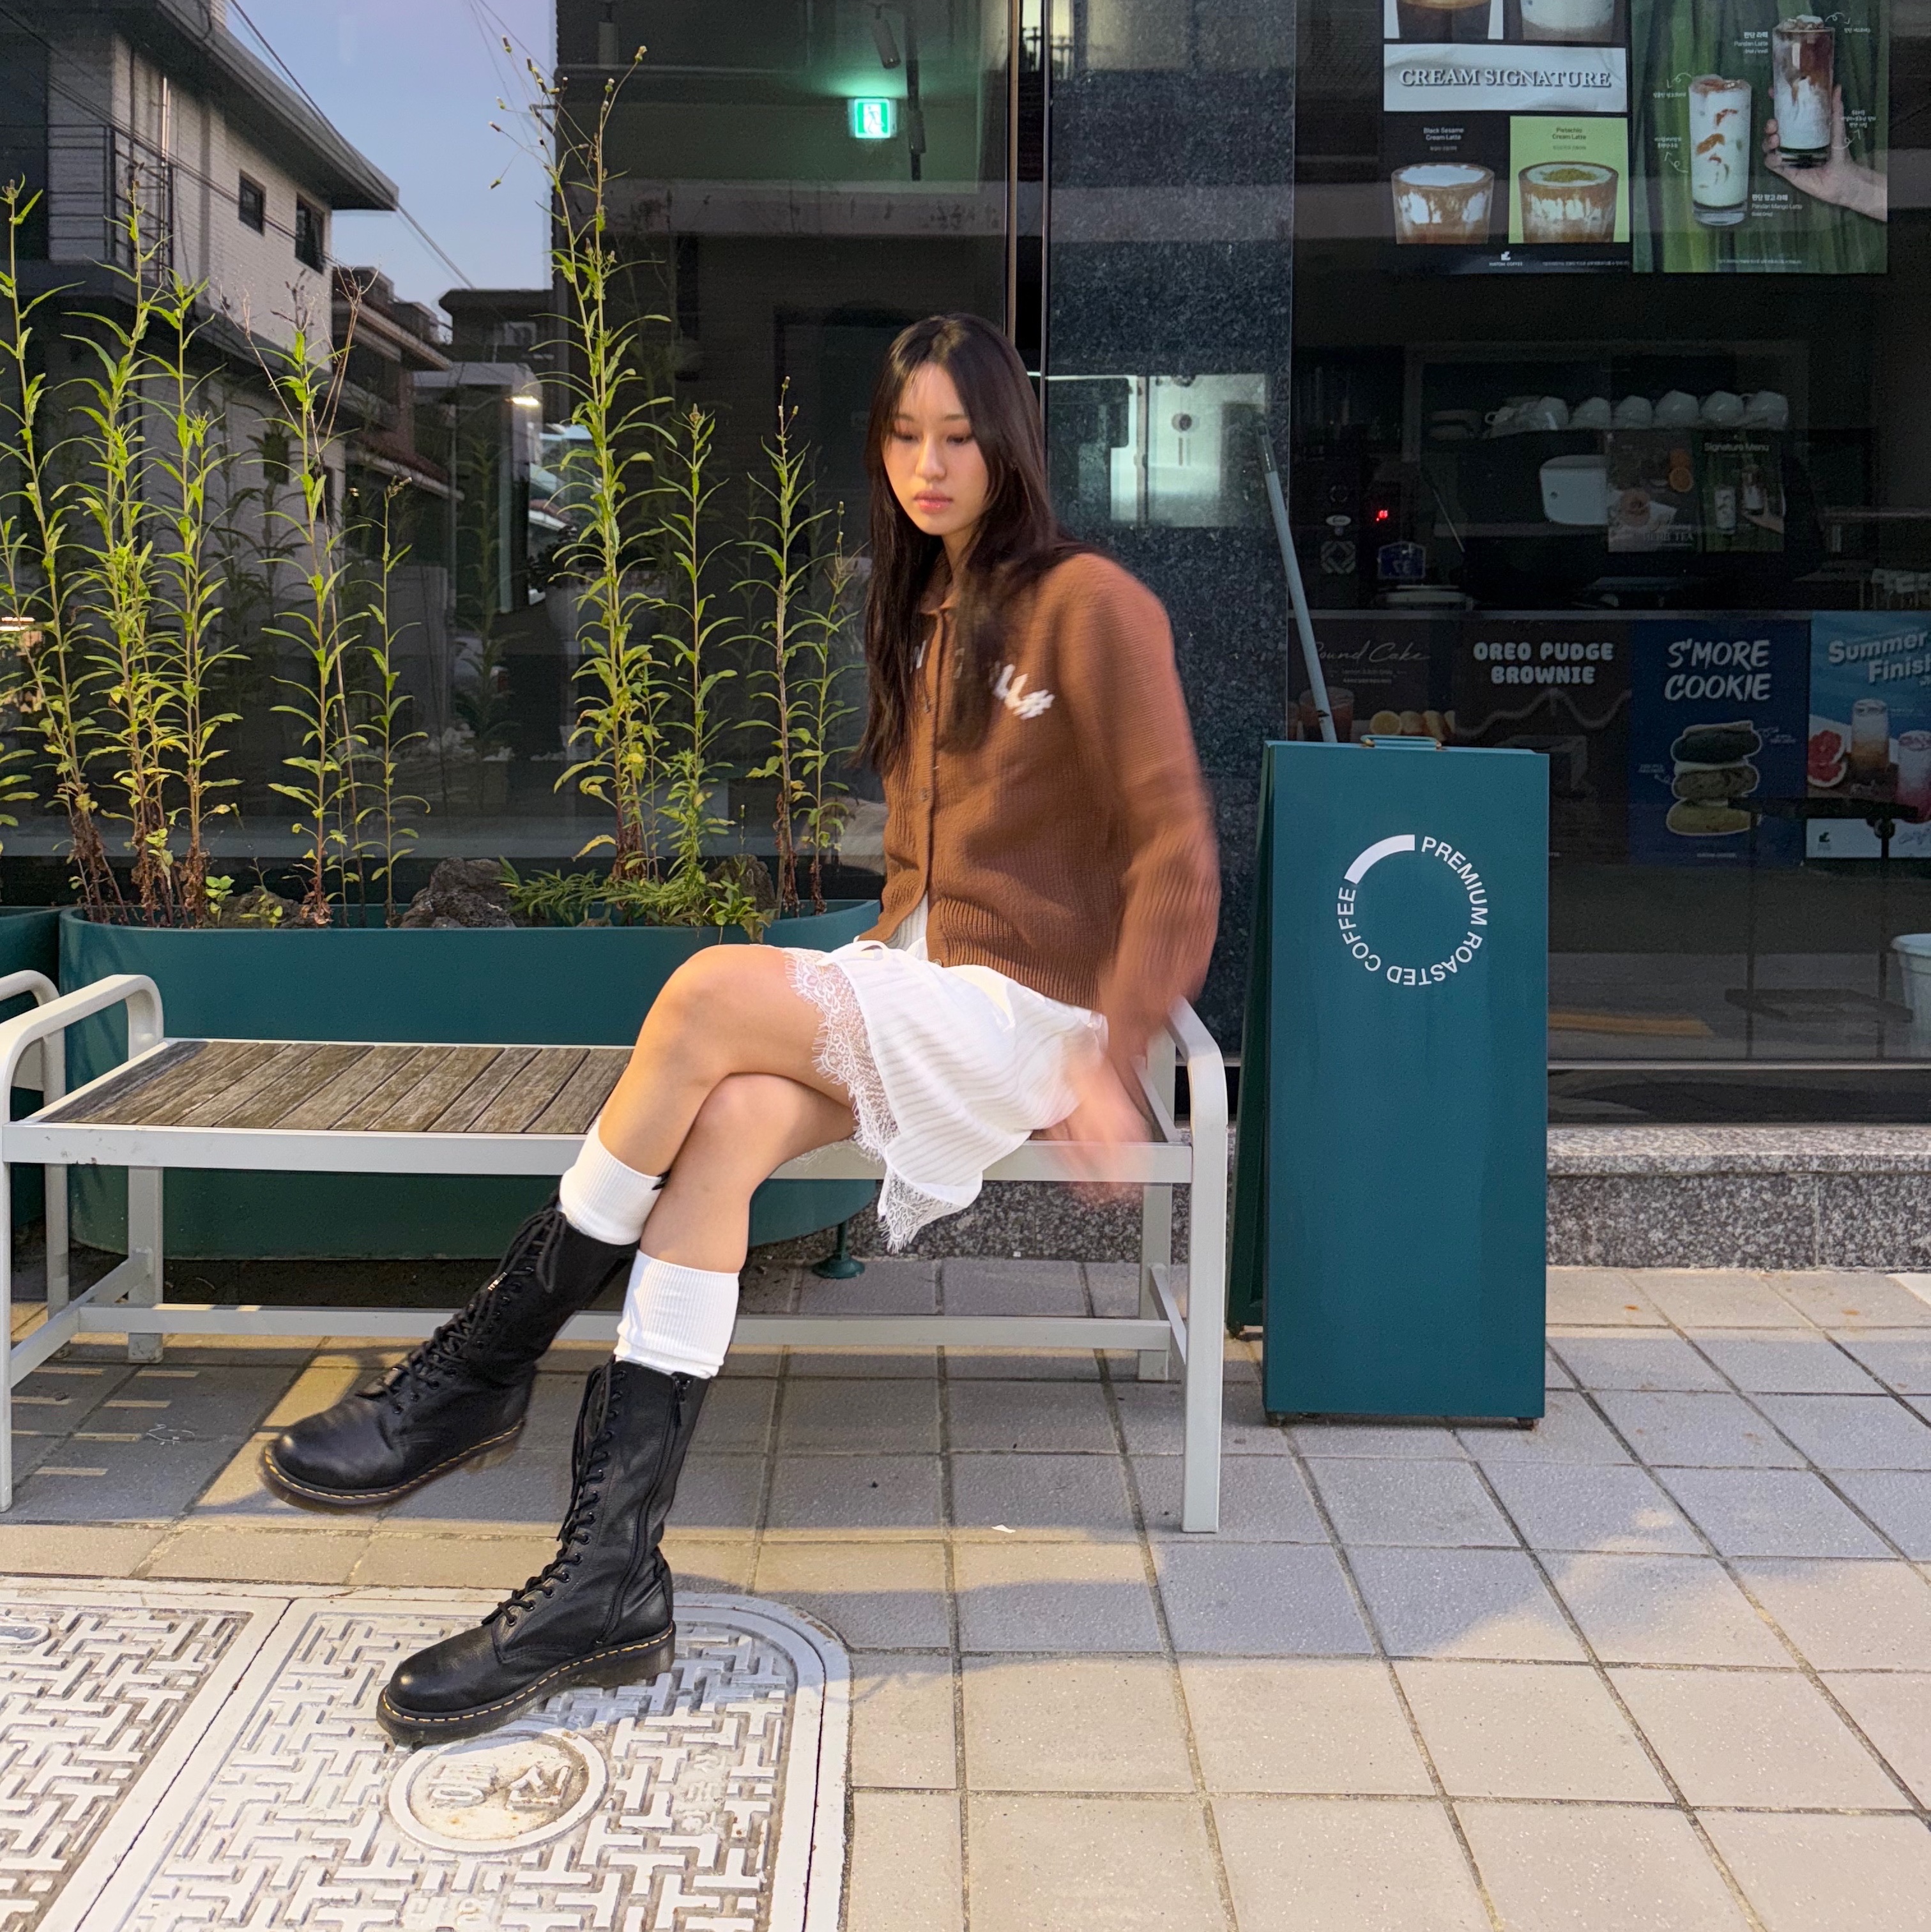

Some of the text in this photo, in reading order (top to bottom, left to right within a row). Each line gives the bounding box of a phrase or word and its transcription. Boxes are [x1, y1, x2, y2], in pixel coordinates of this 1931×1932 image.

[1400, 68, 1612, 88] CREAM SIGNATURE
[1704, 442, 1769, 453] Signature Menu
[1369, 641, 1431, 663] Cake
[1472, 641, 1615, 661] OREO PUDGE
[1667, 637, 1770, 670] S'MORE
[1828, 631, 1928, 664] Summer
[1491, 665, 1596, 685] BROWNIE
[1664, 673, 1773, 701] COOKIE
[1337, 835, 1488, 986] PREMIUM ROASTED COFFEE
